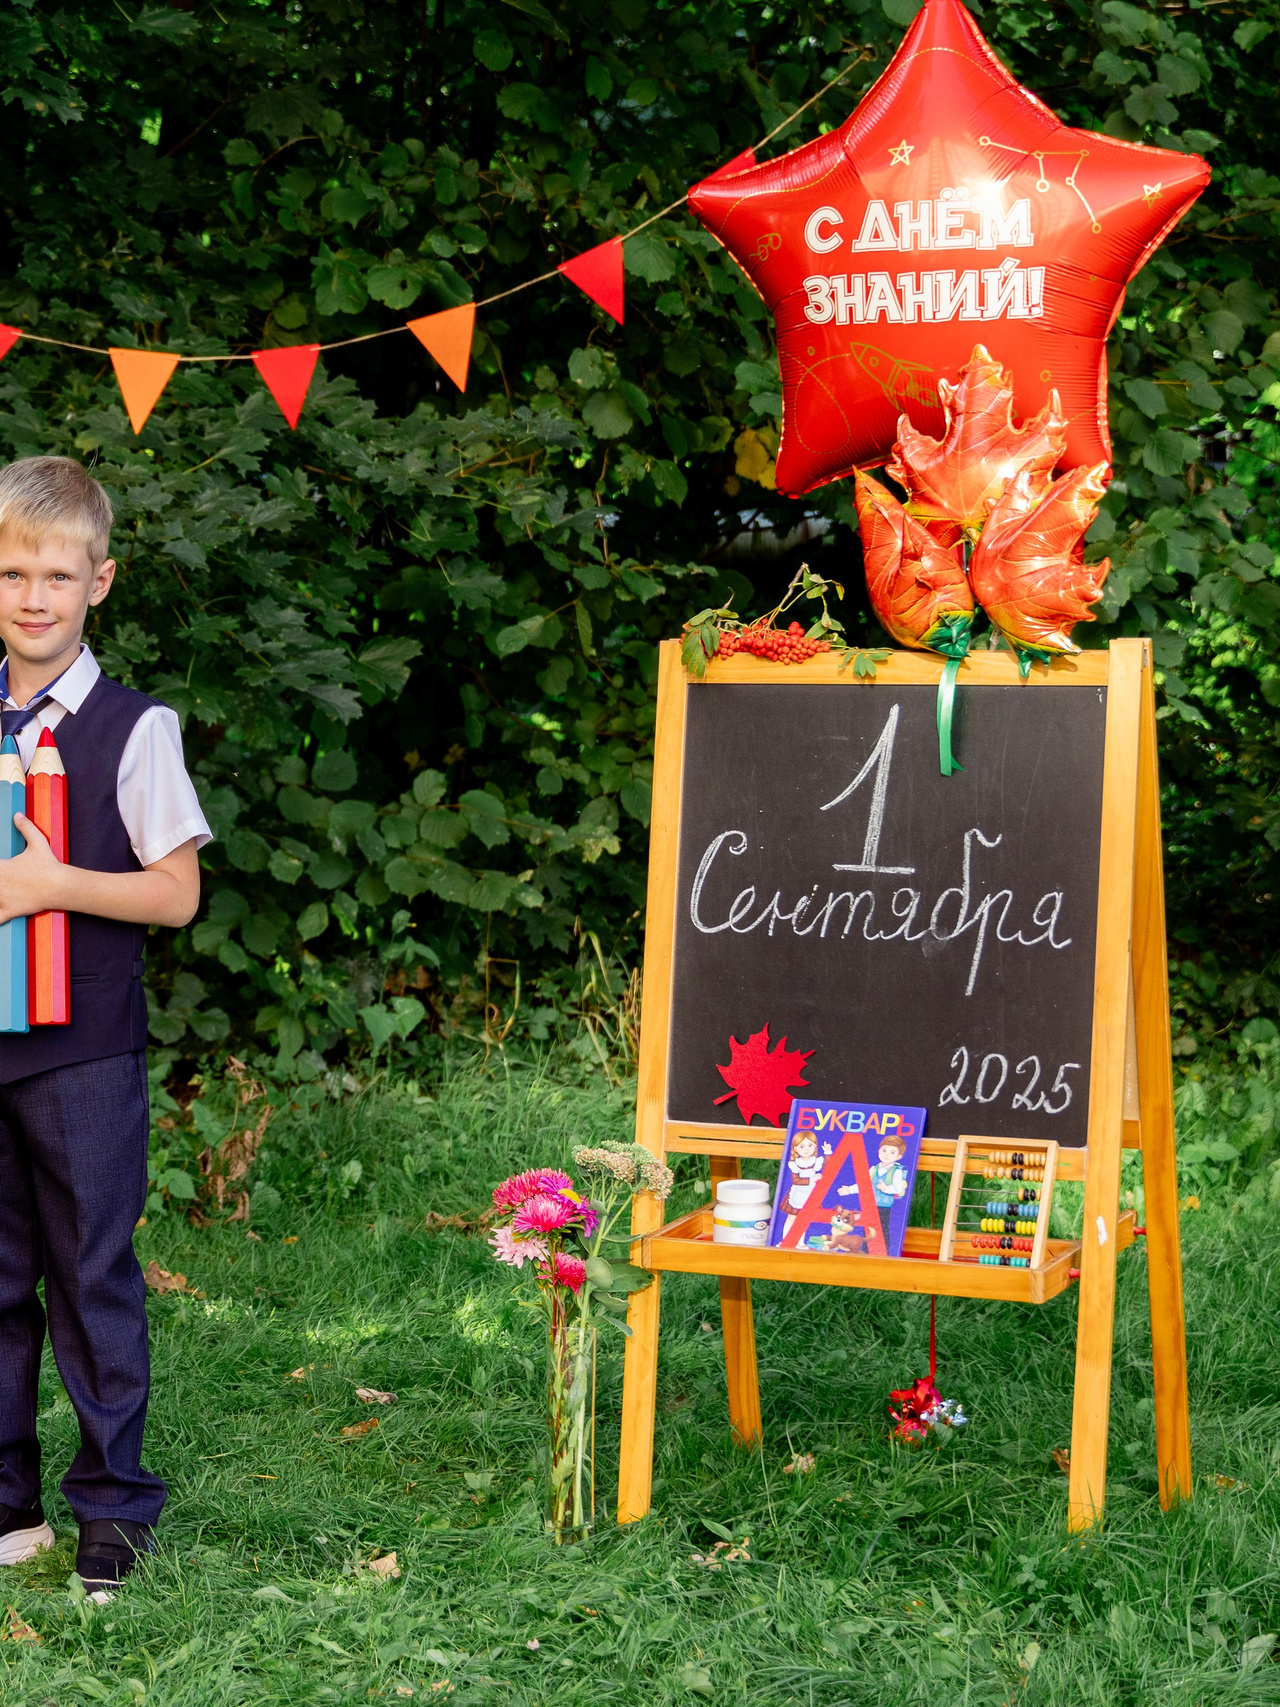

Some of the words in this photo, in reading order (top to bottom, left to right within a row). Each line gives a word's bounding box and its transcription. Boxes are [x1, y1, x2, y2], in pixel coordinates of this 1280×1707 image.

[804, 206, 844, 254] С
[851, 187, 1034, 252] ДНЁМ
[802, 257, 1045, 325] ЗНАНИЙ!
[820, 703, 915, 874] 1
[938, 1046, 1081, 1114] 2025
[796, 1107, 915, 1137] БУКВАРЬ
